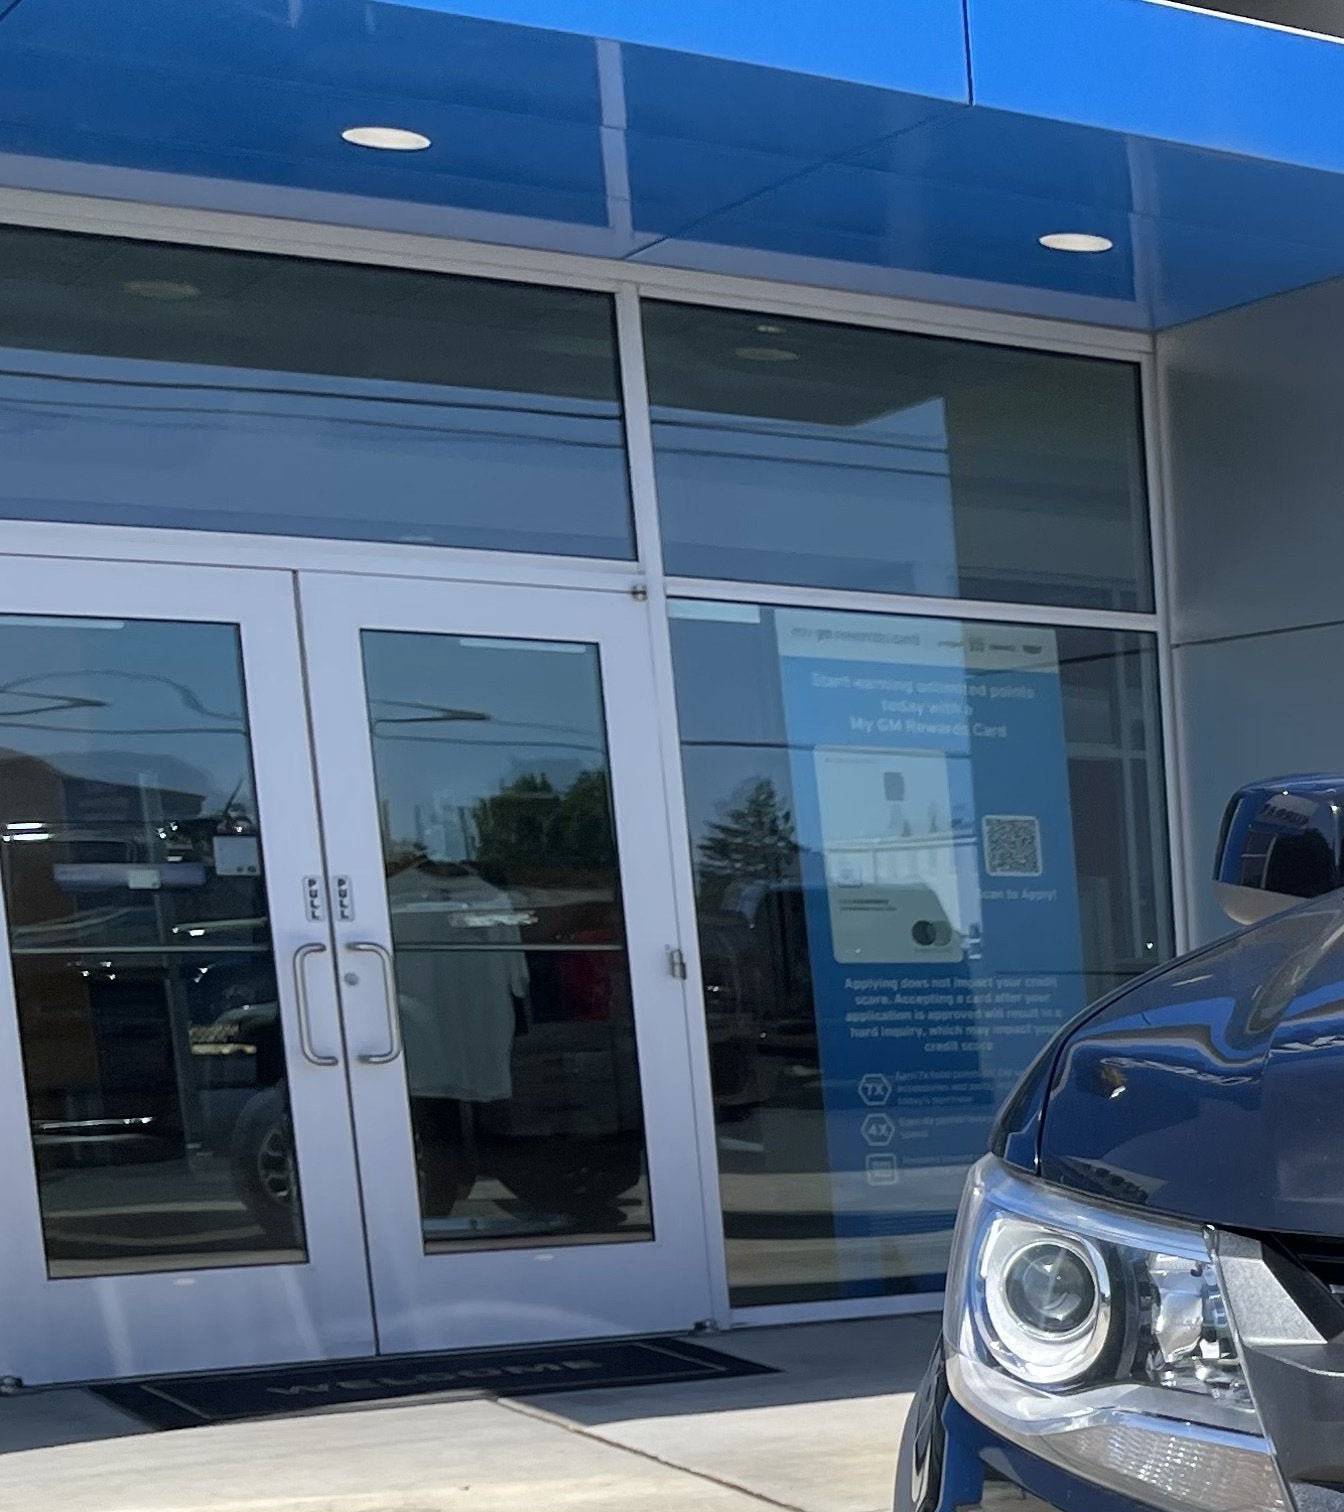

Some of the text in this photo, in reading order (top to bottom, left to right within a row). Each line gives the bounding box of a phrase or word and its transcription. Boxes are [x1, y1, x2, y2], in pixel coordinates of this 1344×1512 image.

[812, 672, 851, 688] Start
[990, 685, 1036, 700] points
[882, 698, 924, 715] today
[849, 717, 1008, 738] My GM Rewards Card
[307, 877, 321, 921] PULL
[337, 877, 350, 920] PULL
[844, 977, 898, 991] Applying
[901, 978, 929, 989] does
[931, 978, 951, 988] not
[953, 977, 993, 989] impact
[996, 979, 1022, 990] your
[894, 993, 954, 1007] Accepting
[966, 993, 991, 1004] card
[1025, 995, 1051, 1006] your
[846, 1010, 912, 1023] application
[914, 1010, 925, 1021] is
[927, 1009, 982, 1022] approved
[850, 1026, 879, 1038] hard
[928, 1026, 963, 1037] which
[965, 1027, 990, 1039] may
[924, 1040, 958, 1052] credit
[865, 1083, 886, 1097] 7X
[867, 1123, 889, 1136] 4X
[265, 1359, 603, 1396] WELCOME
